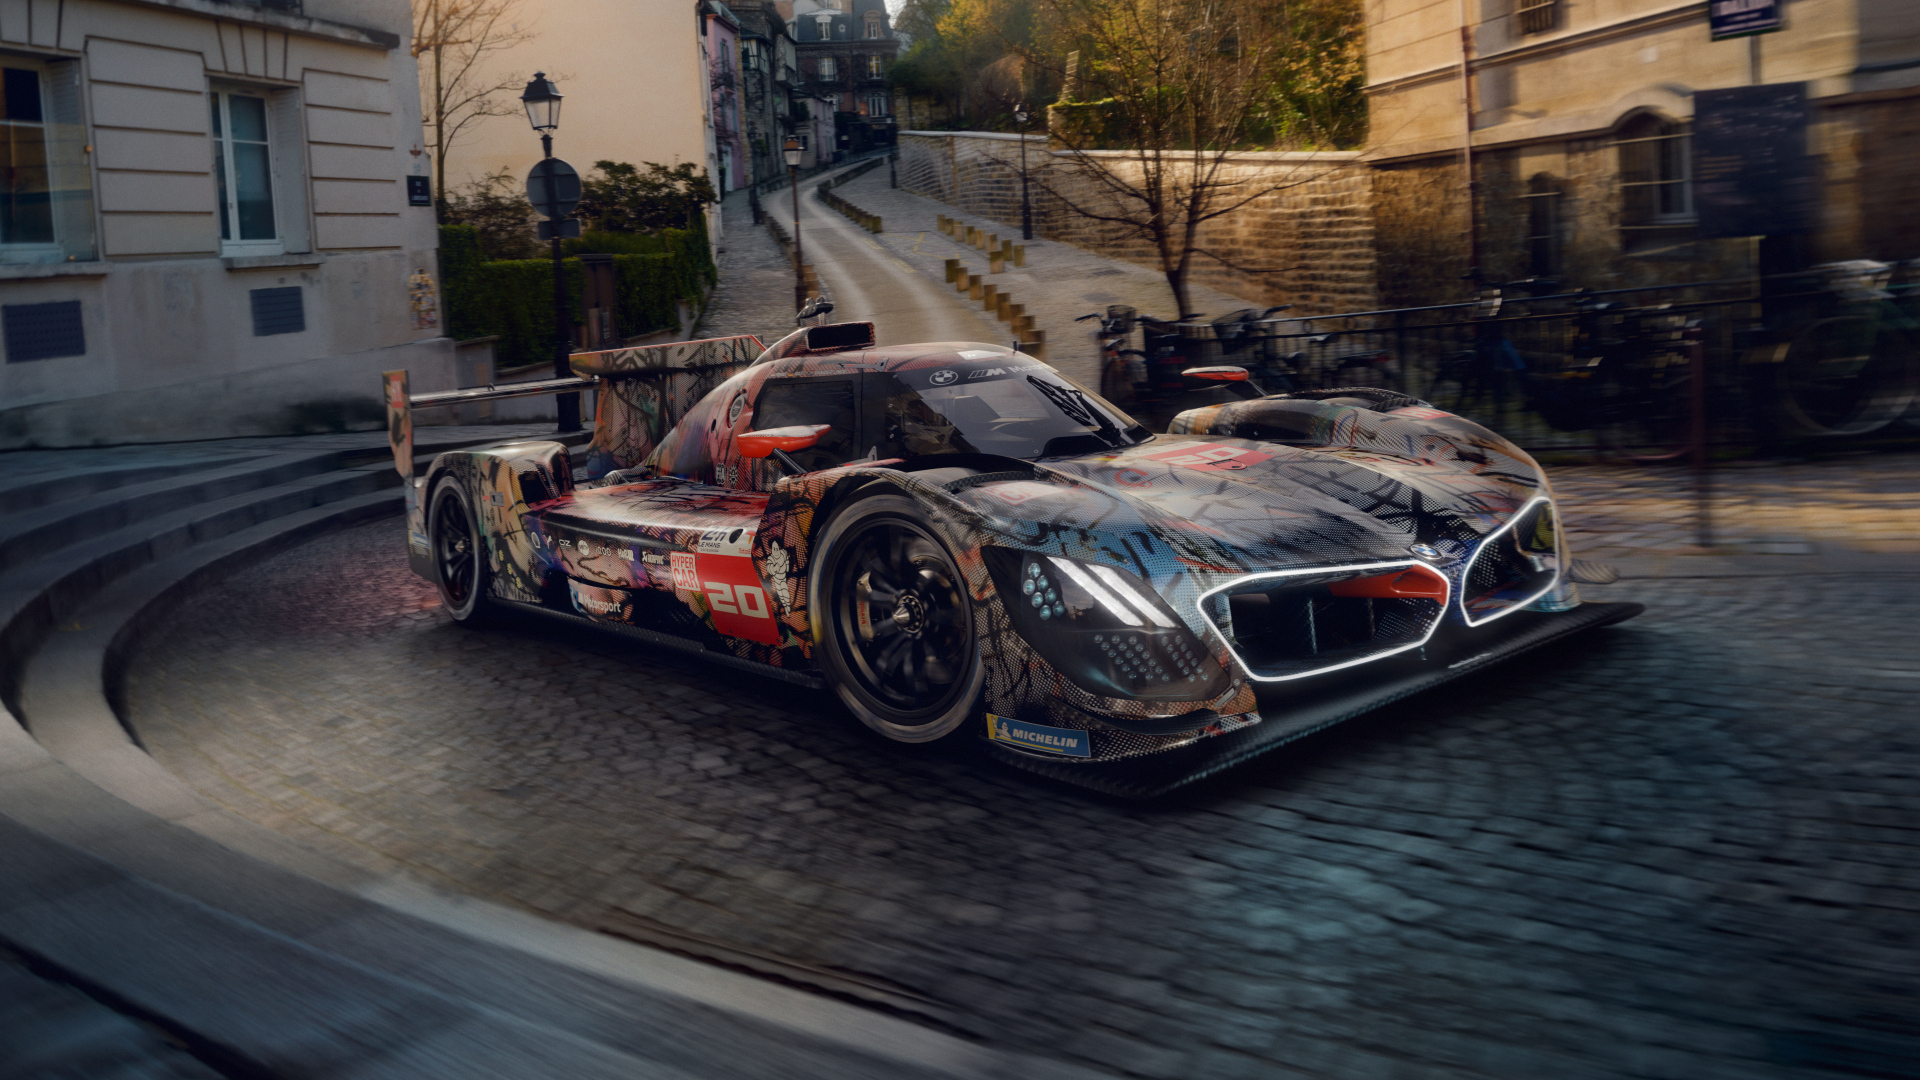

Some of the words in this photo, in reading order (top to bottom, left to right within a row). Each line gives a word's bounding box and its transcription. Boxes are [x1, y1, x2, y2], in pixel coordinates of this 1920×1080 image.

[1158, 446, 1250, 466] 20
[672, 554, 695, 570] HYPER
[673, 567, 699, 589] CAR
[703, 581, 770, 619] 20
[1012, 728, 1078, 748] MICHELIN
